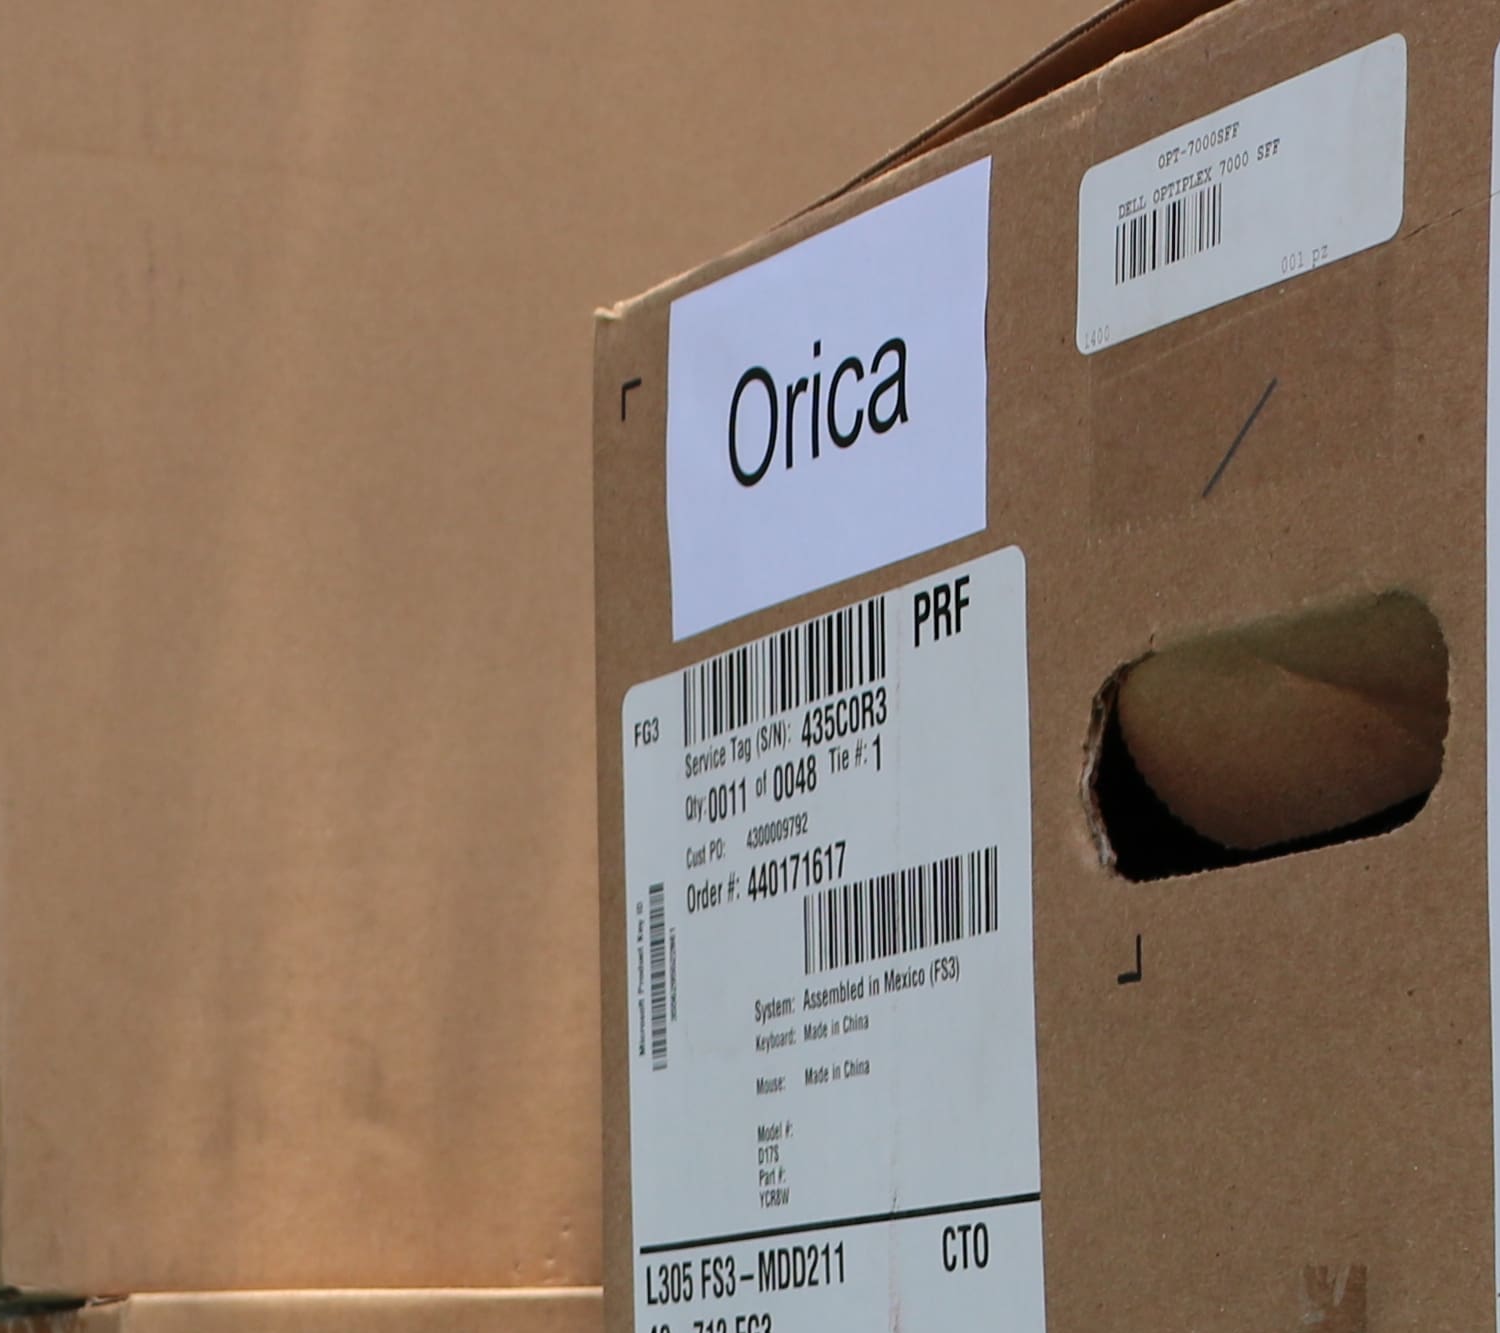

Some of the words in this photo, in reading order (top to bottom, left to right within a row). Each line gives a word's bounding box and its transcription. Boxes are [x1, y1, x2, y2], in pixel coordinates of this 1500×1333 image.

[1118, 196, 1146, 220] DELL
[1153, 167, 1212, 204] OPTIPLEX
[1219, 151, 1249, 176] 7000
[1257, 138, 1281, 162] SFF
[1158, 122, 1240, 170] OPT-7000SFF
[728, 336, 910, 488] Orica
[913, 575, 971, 648] PRF
[634, 718, 660, 748] FG3
[684, 744, 726, 779] Service
[730, 735, 752, 767] Tag
[756, 774, 768, 798] of
[773, 755, 818, 801] 0048
[828, 748, 849, 774] Tie
[873, 734, 882, 772] 1
[687, 879, 723, 914] Order
[747, 840, 847, 902] 440171617
[754, 995, 796, 1023] System:
[803, 978, 864, 1010] Assembled
[868, 974, 880, 995] in
[884, 966, 926, 993] Mexico
[929, 955, 961, 986] (FS3)
[645, 1258, 694, 1306] L305
[942, 1221, 990, 1274] CTO
